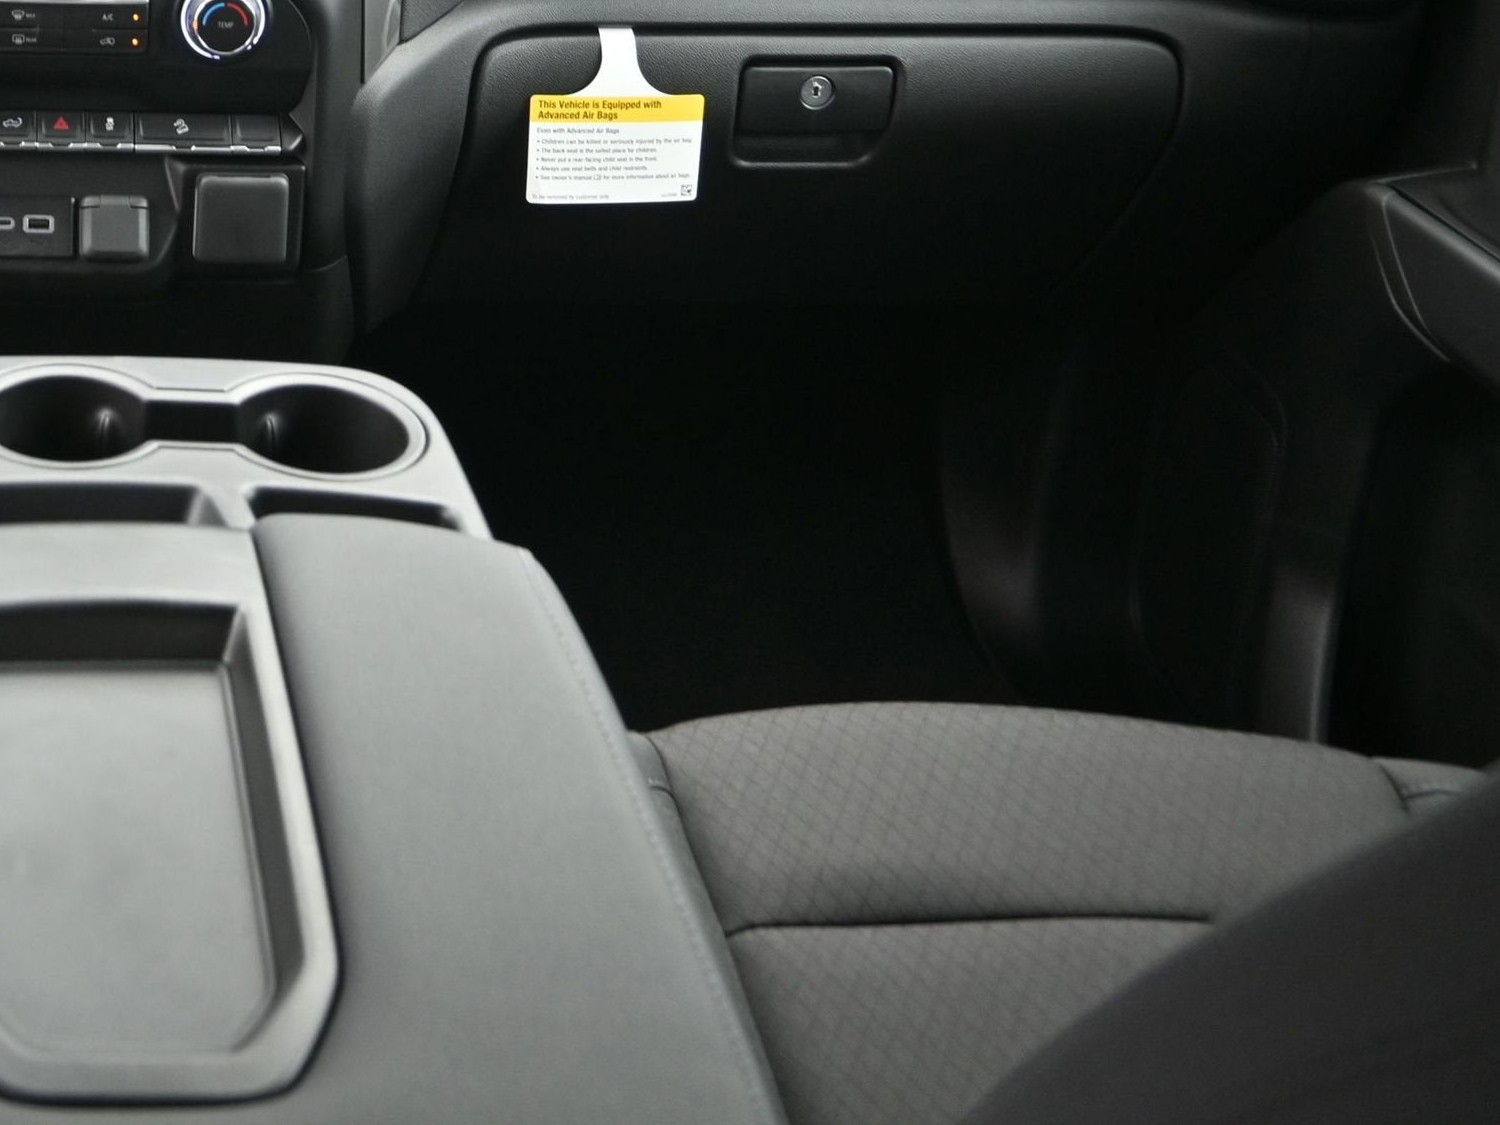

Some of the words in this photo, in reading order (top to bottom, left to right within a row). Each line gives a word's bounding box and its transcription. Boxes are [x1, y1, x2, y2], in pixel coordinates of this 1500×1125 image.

[102, 13, 114, 21] A/C
[539, 100, 556, 109] This
[559, 100, 590, 109] Vehicle
[592, 100, 599, 109] is
[602, 100, 641, 110] Equipped
[644, 100, 662, 109] with
[538, 111, 580, 119] Advanced
[582, 111, 594, 119] Air
[597, 111, 618, 121] Bags
